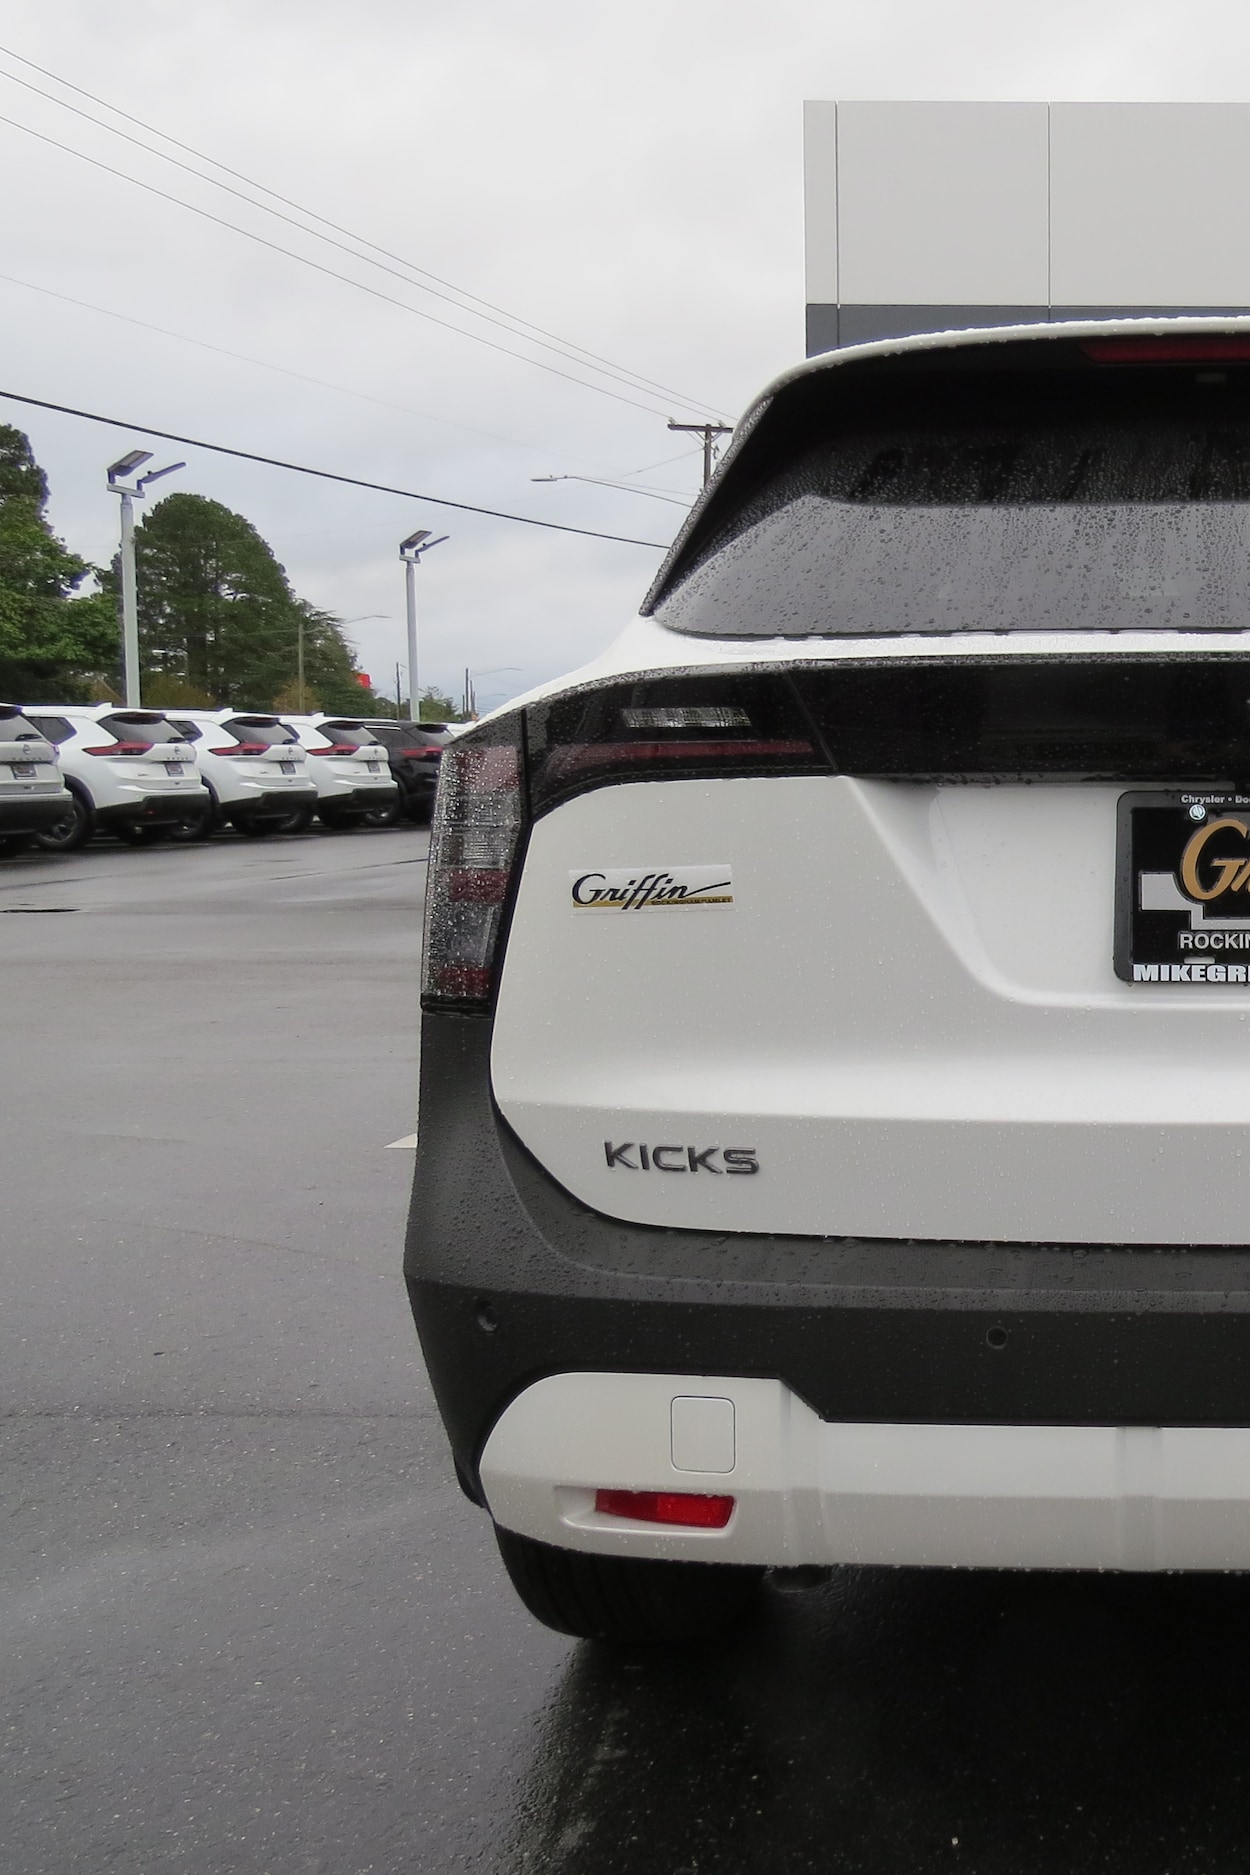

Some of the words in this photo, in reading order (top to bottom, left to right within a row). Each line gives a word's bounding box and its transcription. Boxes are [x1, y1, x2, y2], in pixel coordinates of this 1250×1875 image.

[1181, 794, 1225, 805] Chrysler
[572, 873, 731, 910] Griffin
[604, 1140, 760, 1175] KICKS
